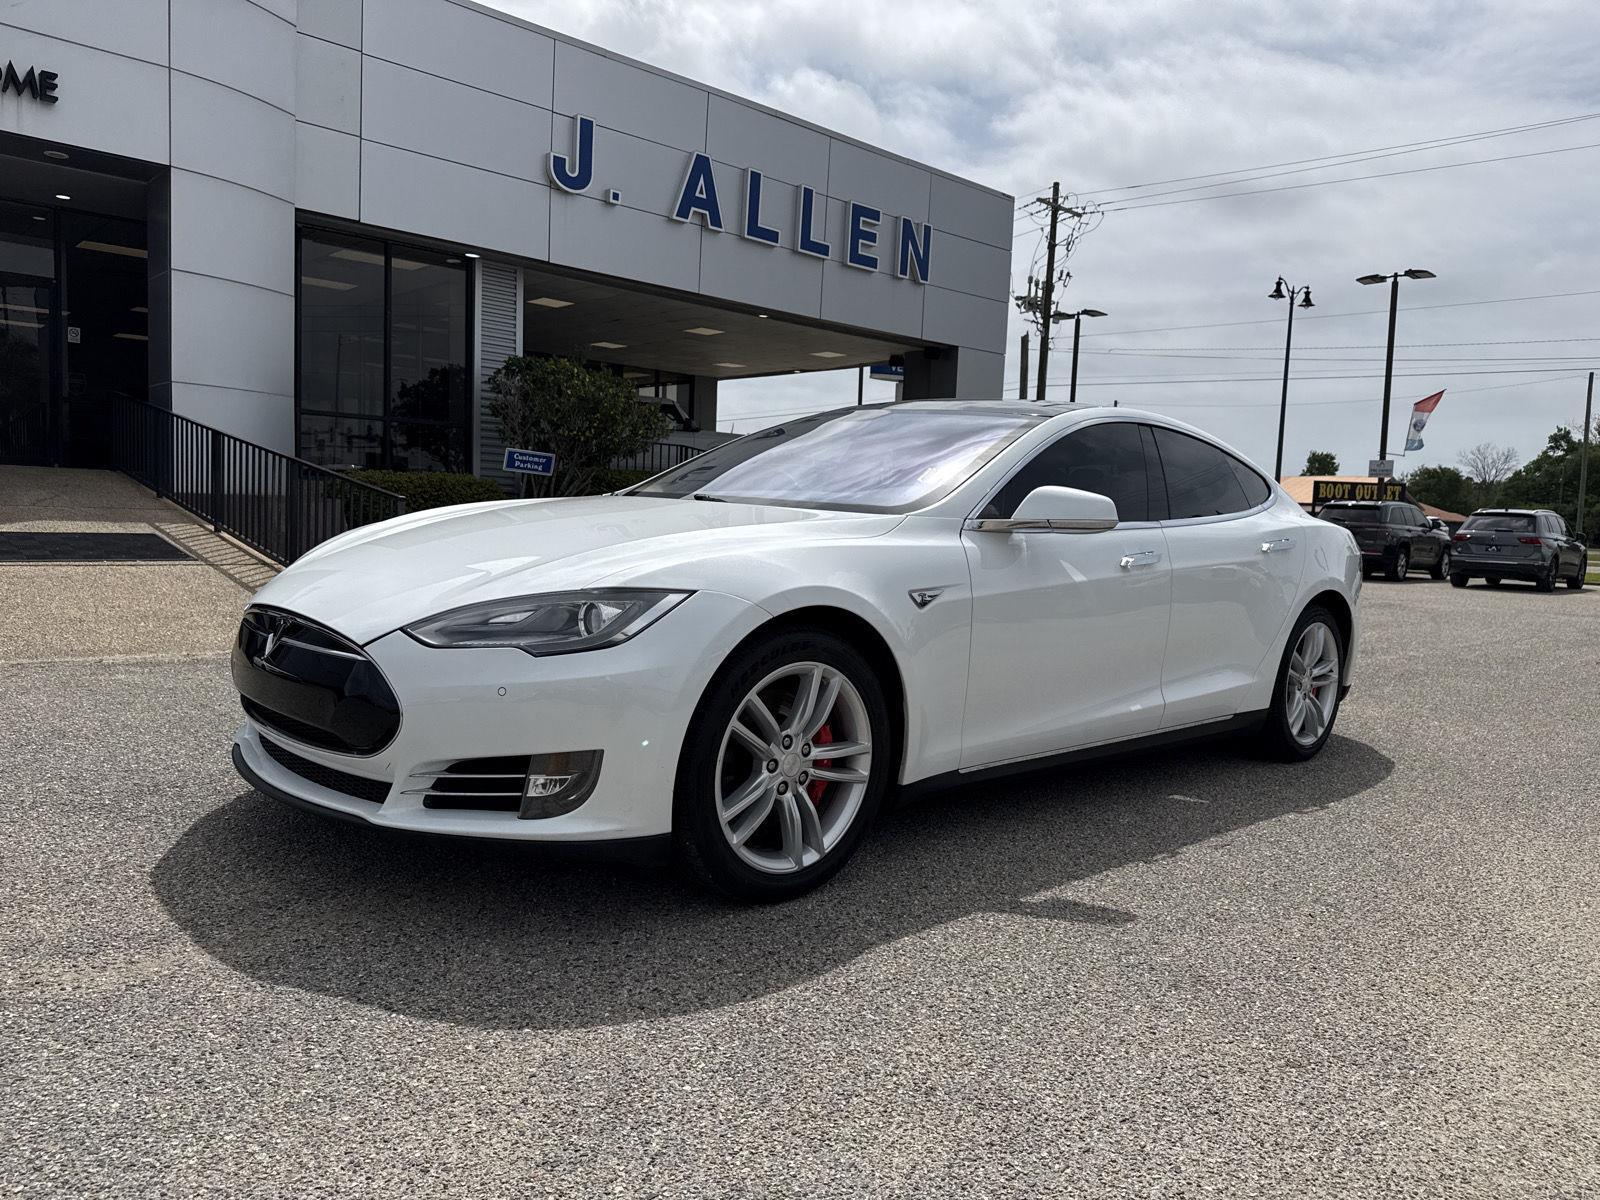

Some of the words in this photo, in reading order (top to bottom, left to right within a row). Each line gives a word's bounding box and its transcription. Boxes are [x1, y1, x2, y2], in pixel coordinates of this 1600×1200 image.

[0, 59, 59, 104] ME
[546, 114, 622, 205] J.
[671, 151, 933, 284] ALLEN
[513, 453, 547, 463] Customer
[514, 460, 543, 471] Parking
[1318, 483, 1351, 498] BOOT
[1355, 484, 1402, 500] OUTET
